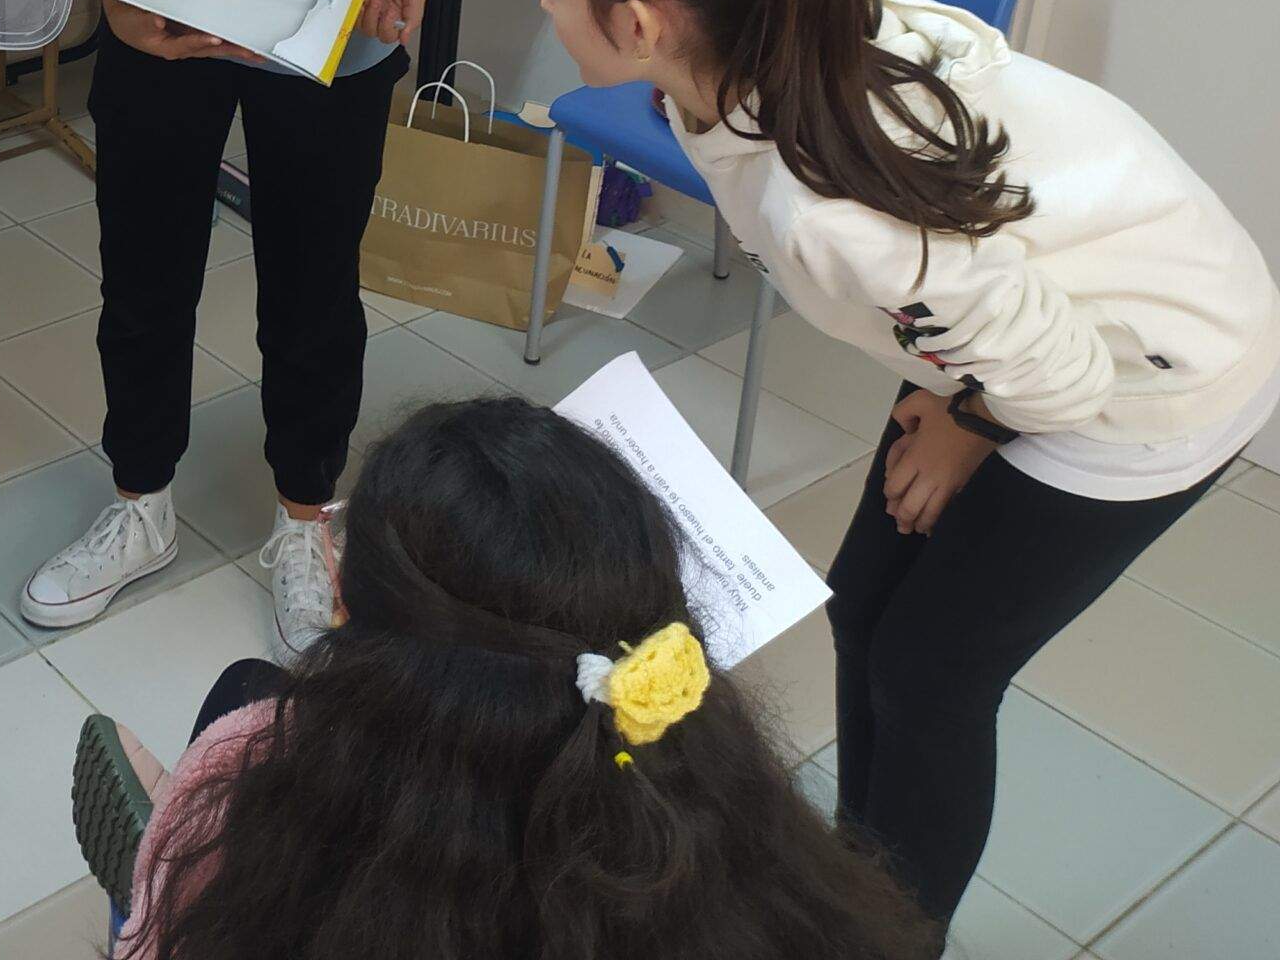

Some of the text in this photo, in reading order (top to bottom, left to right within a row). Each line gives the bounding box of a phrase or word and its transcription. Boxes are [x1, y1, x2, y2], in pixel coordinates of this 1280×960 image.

[371, 194, 537, 248] TRADIVARIUS
[625, 435, 649, 465] hacer
[653, 472, 670, 492] van
[678, 503, 705, 536] hueso
[712, 545, 735, 571] tanto
[736, 573, 762, 602] duele
